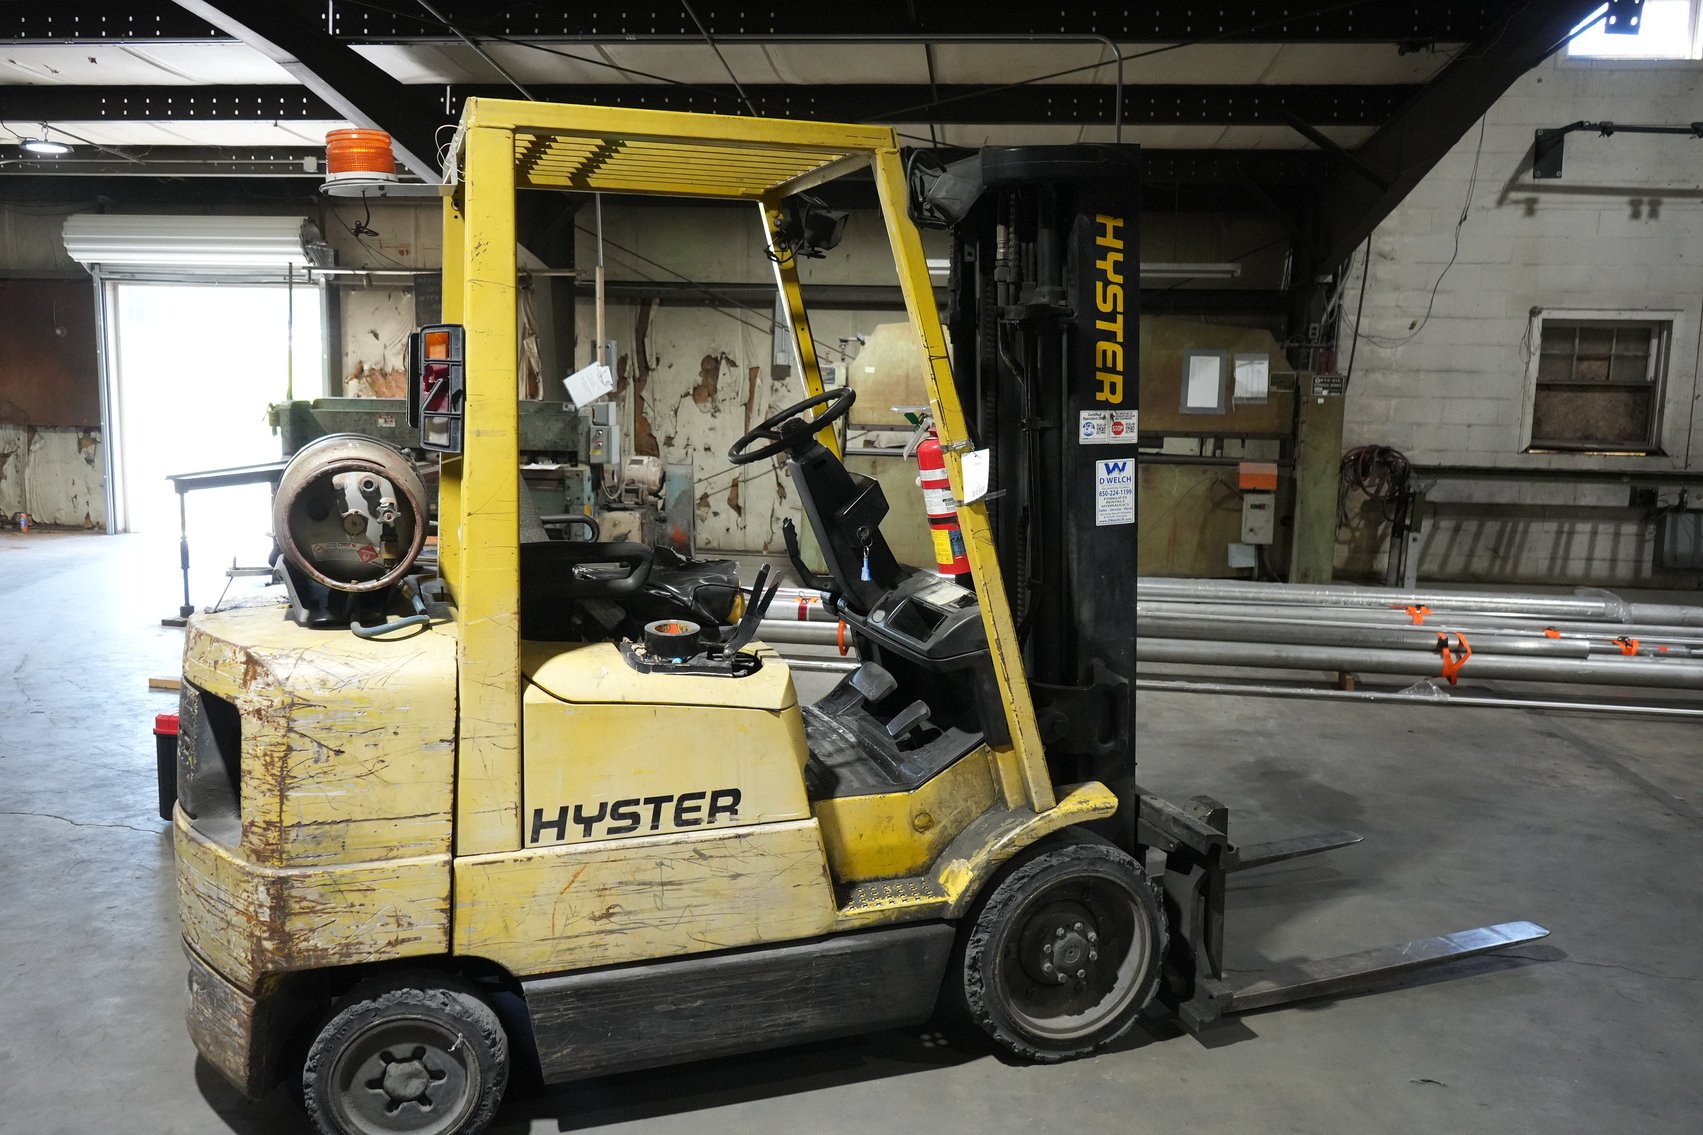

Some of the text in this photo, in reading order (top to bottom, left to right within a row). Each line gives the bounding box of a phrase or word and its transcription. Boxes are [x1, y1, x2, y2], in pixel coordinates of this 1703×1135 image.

[1096, 214, 1124, 404] HYSTER
[1099, 489, 1133, 497] 850-224-1199
[1100, 476, 1132, 485] D WELCH
[530, 788, 742, 844] HYSTER
